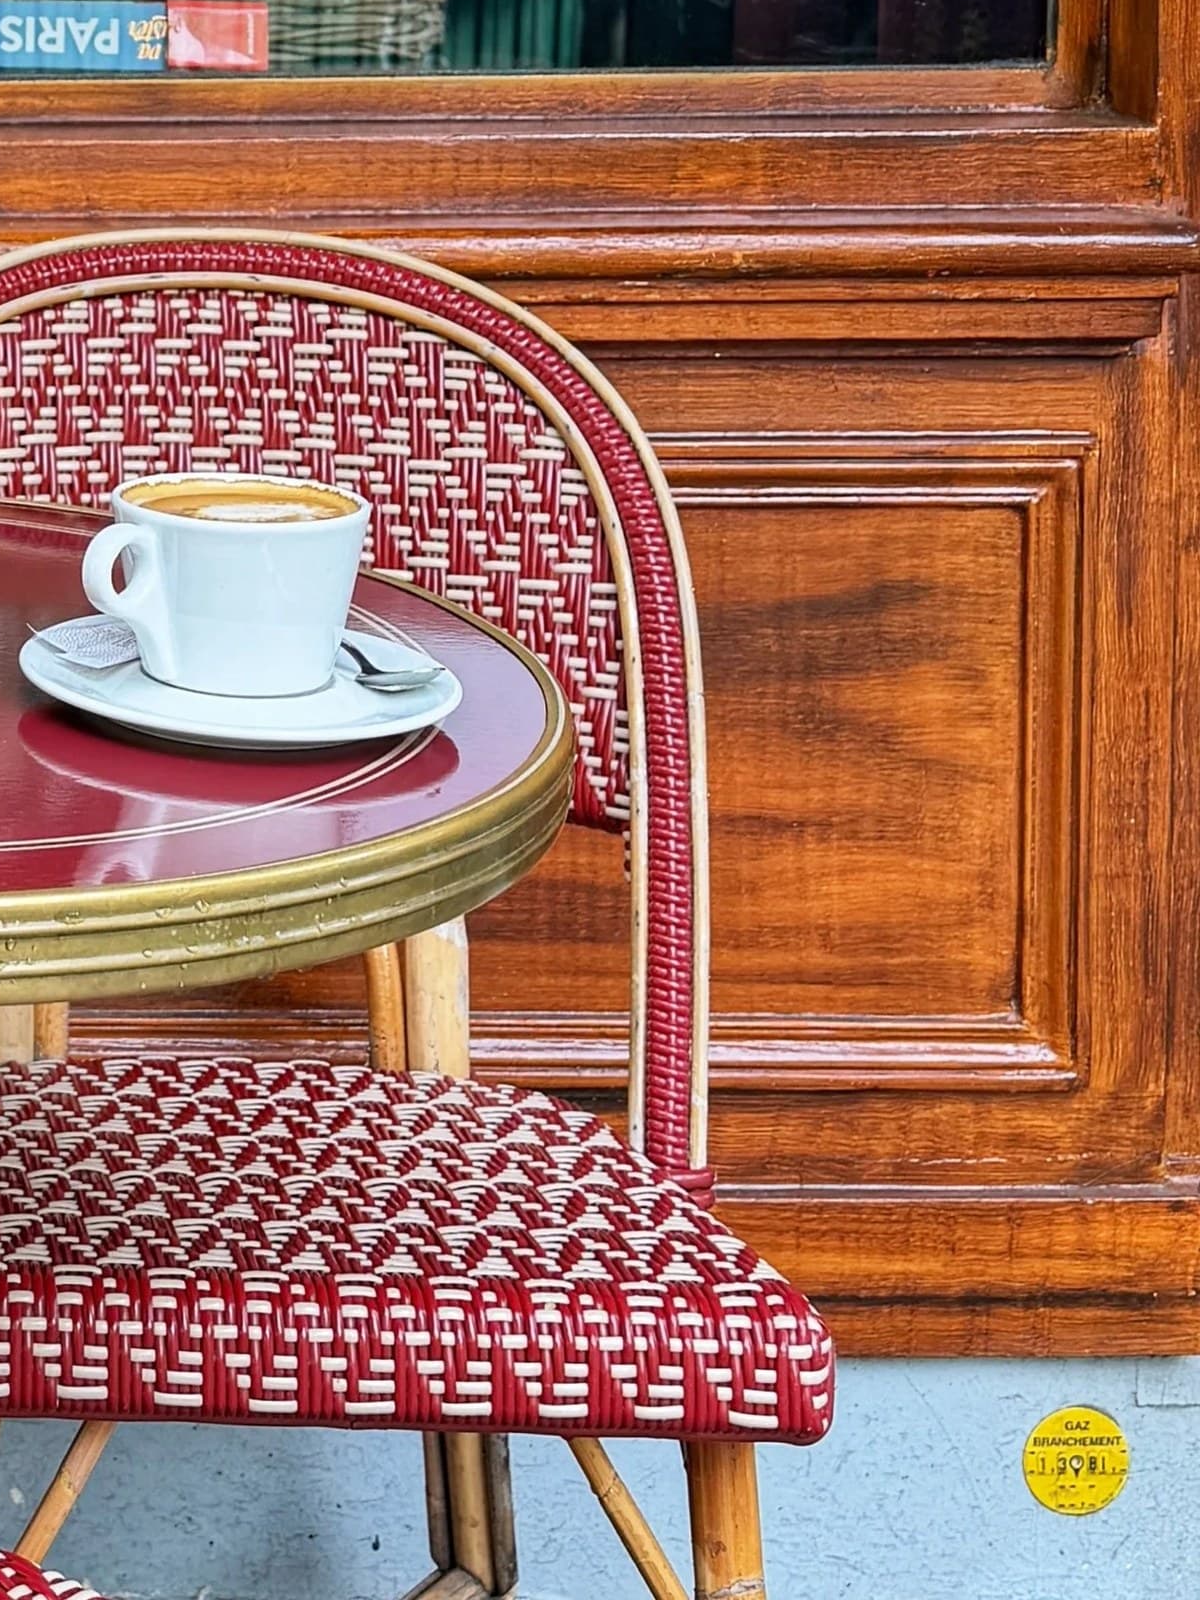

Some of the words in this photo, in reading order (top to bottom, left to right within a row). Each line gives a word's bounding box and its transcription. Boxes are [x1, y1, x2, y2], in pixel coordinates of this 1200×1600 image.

[0, 15, 120, 55] PARIS
[1064, 1420, 1090, 1431] GAZ
[1033, 1436, 1122, 1447] BRANCHEMENT
